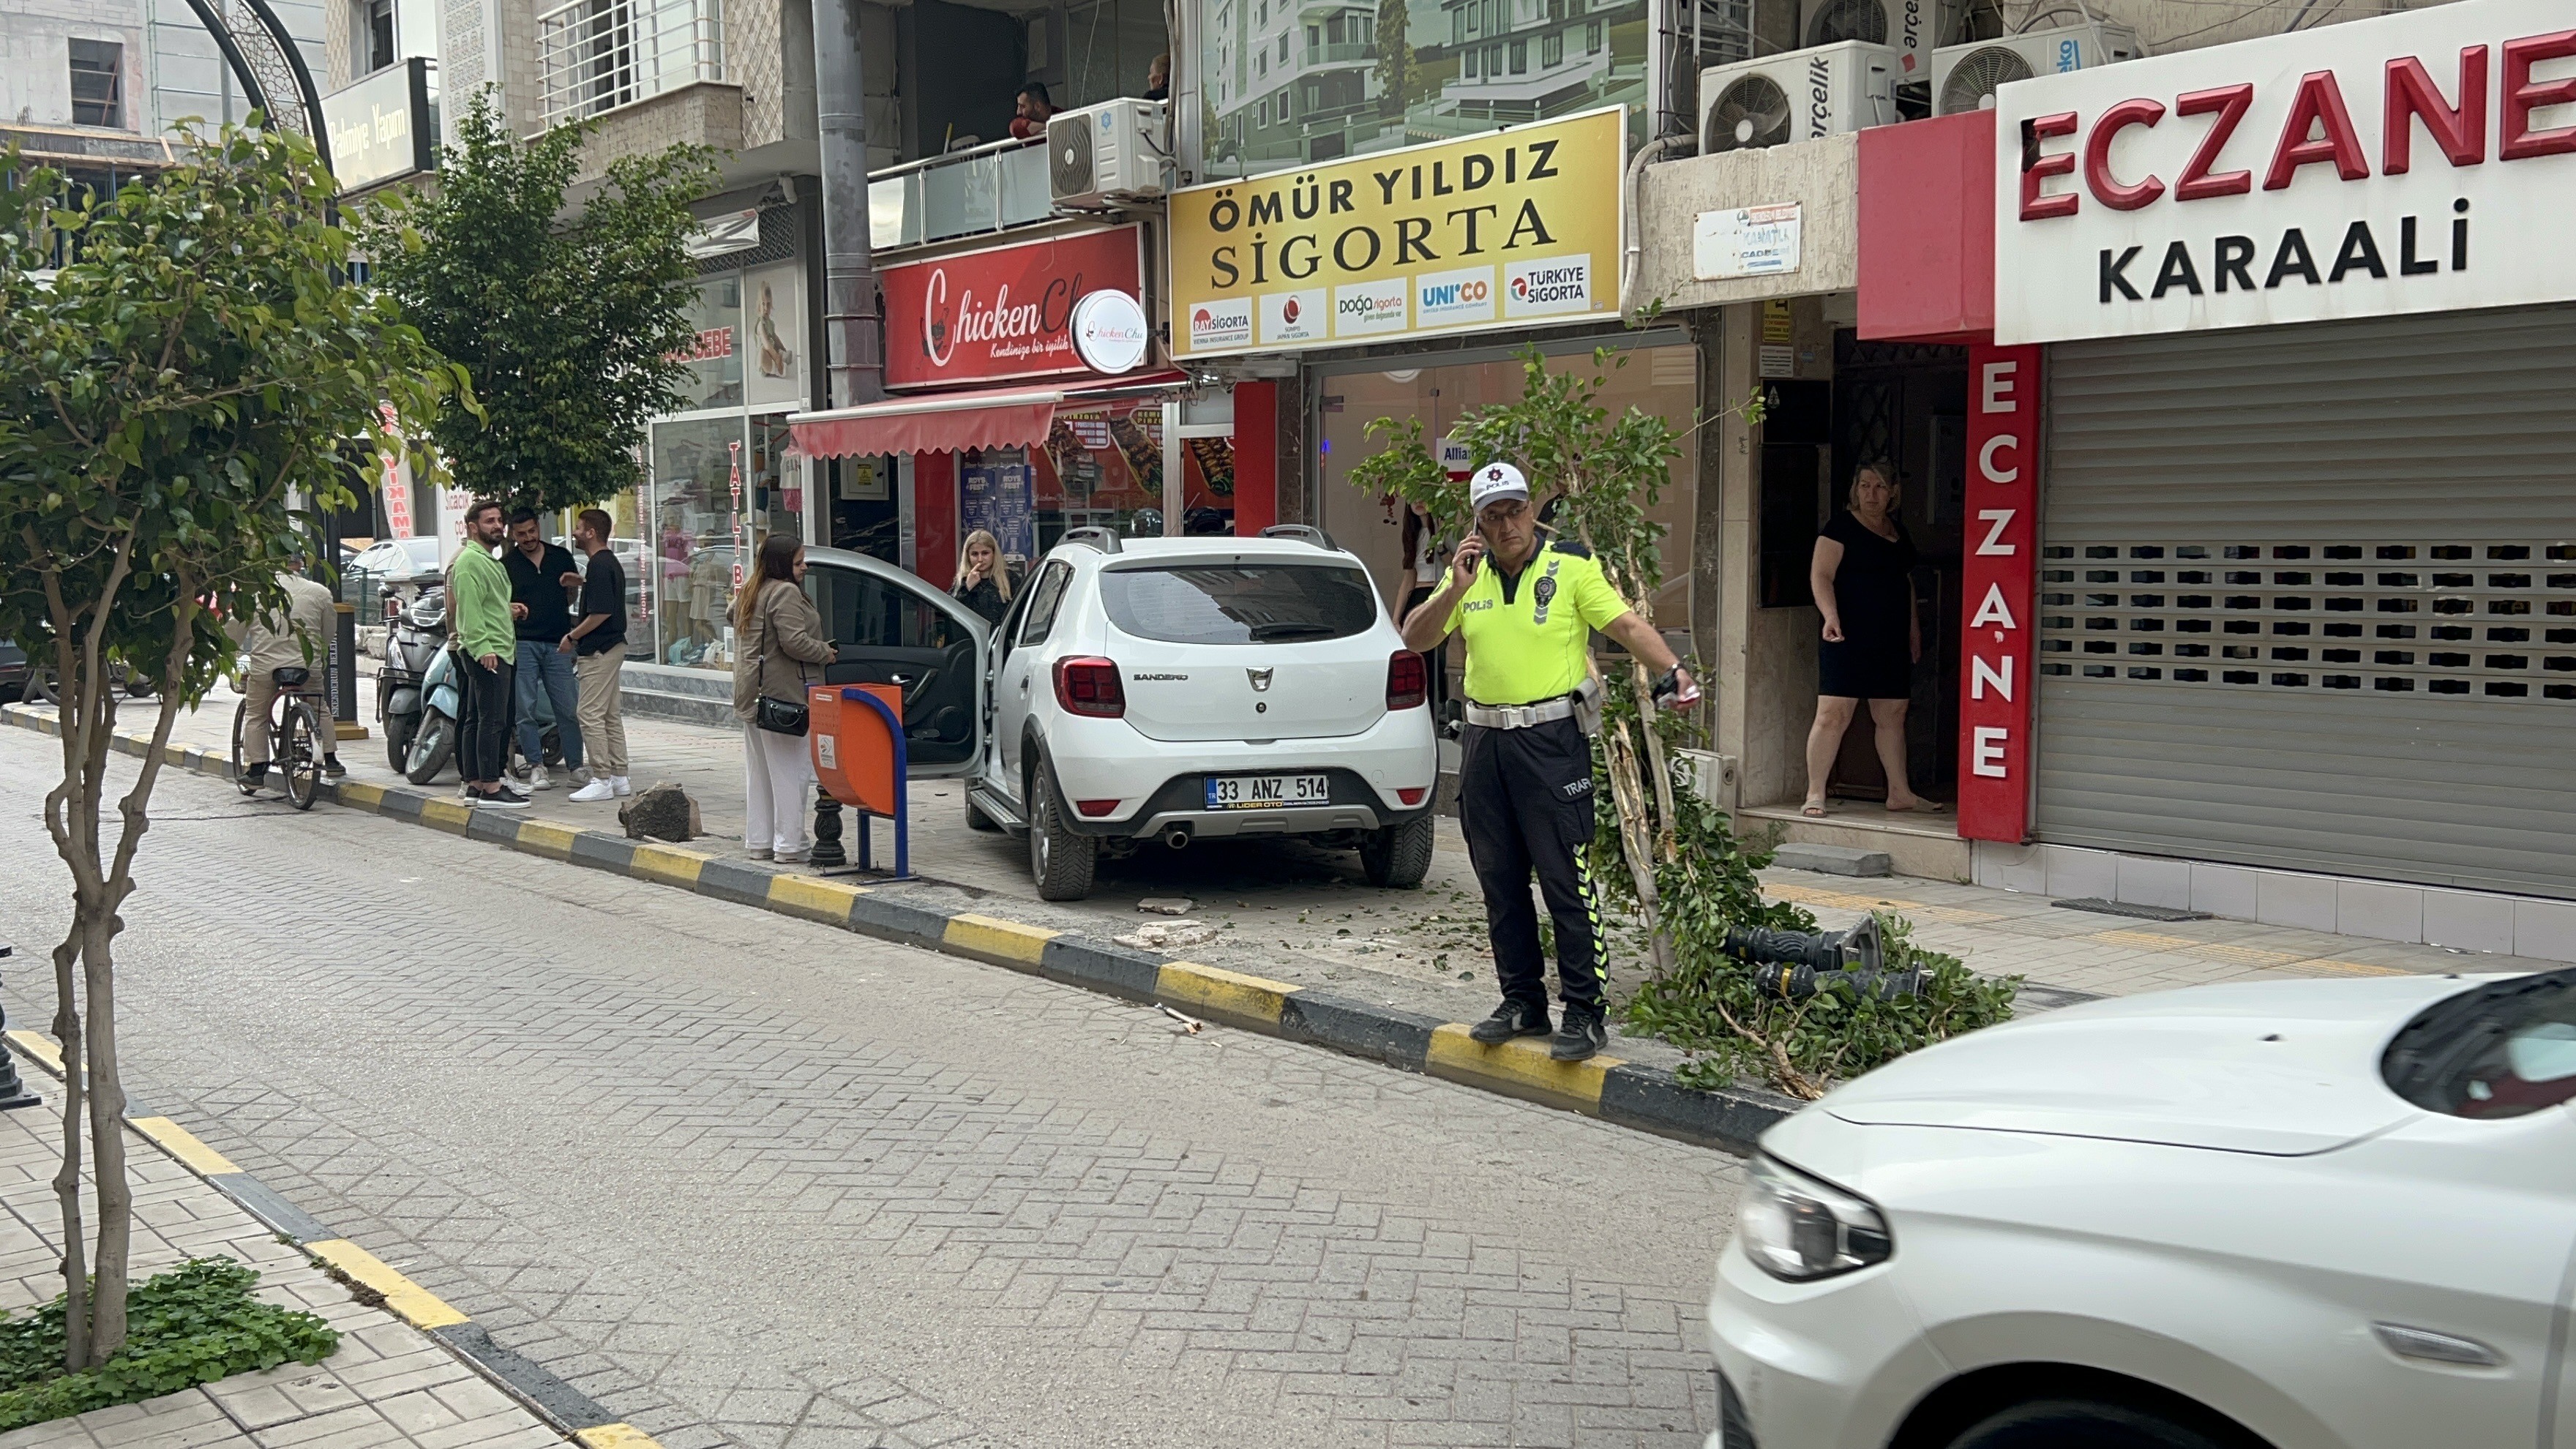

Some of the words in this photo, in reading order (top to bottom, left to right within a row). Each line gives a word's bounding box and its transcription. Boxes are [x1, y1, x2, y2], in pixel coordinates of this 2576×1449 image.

[1904, 0, 1922, 48] arçe
[2056, 40, 2073, 73] eko
[329, 117, 370, 160] Palmiye
[372, 102, 405, 150] Yapım
[2020, 29, 2576, 222] ECZANE
[1209, 173, 1355, 233] ÖMÜR
[1374, 139, 1559, 205] YILDIZ
[1211, 198, 1557, 290] SİGORTA
[2099, 198, 2471, 304] KARAALİ
[1528, 267, 1584, 286] TÜRKİYE
[1528, 285, 1584, 303] SİGORTA
[925, 268, 1045, 367] Chicken
[1194, 320, 1211, 331] RAY
[1212, 315, 1248, 330] SİGORTA
[1032, 337, 1044, 353] bir
[1045, 334, 1068, 358] iyilik
[1445, 446, 1473, 461] Allia
[729, 441, 741, 557] TATLI
[1969, 361, 2018, 778] ECZANE
[1218, 781, 1238, 800] 33
[1251, 779, 1283, 799] ANZ
[1297, 777, 1325, 798] 514
